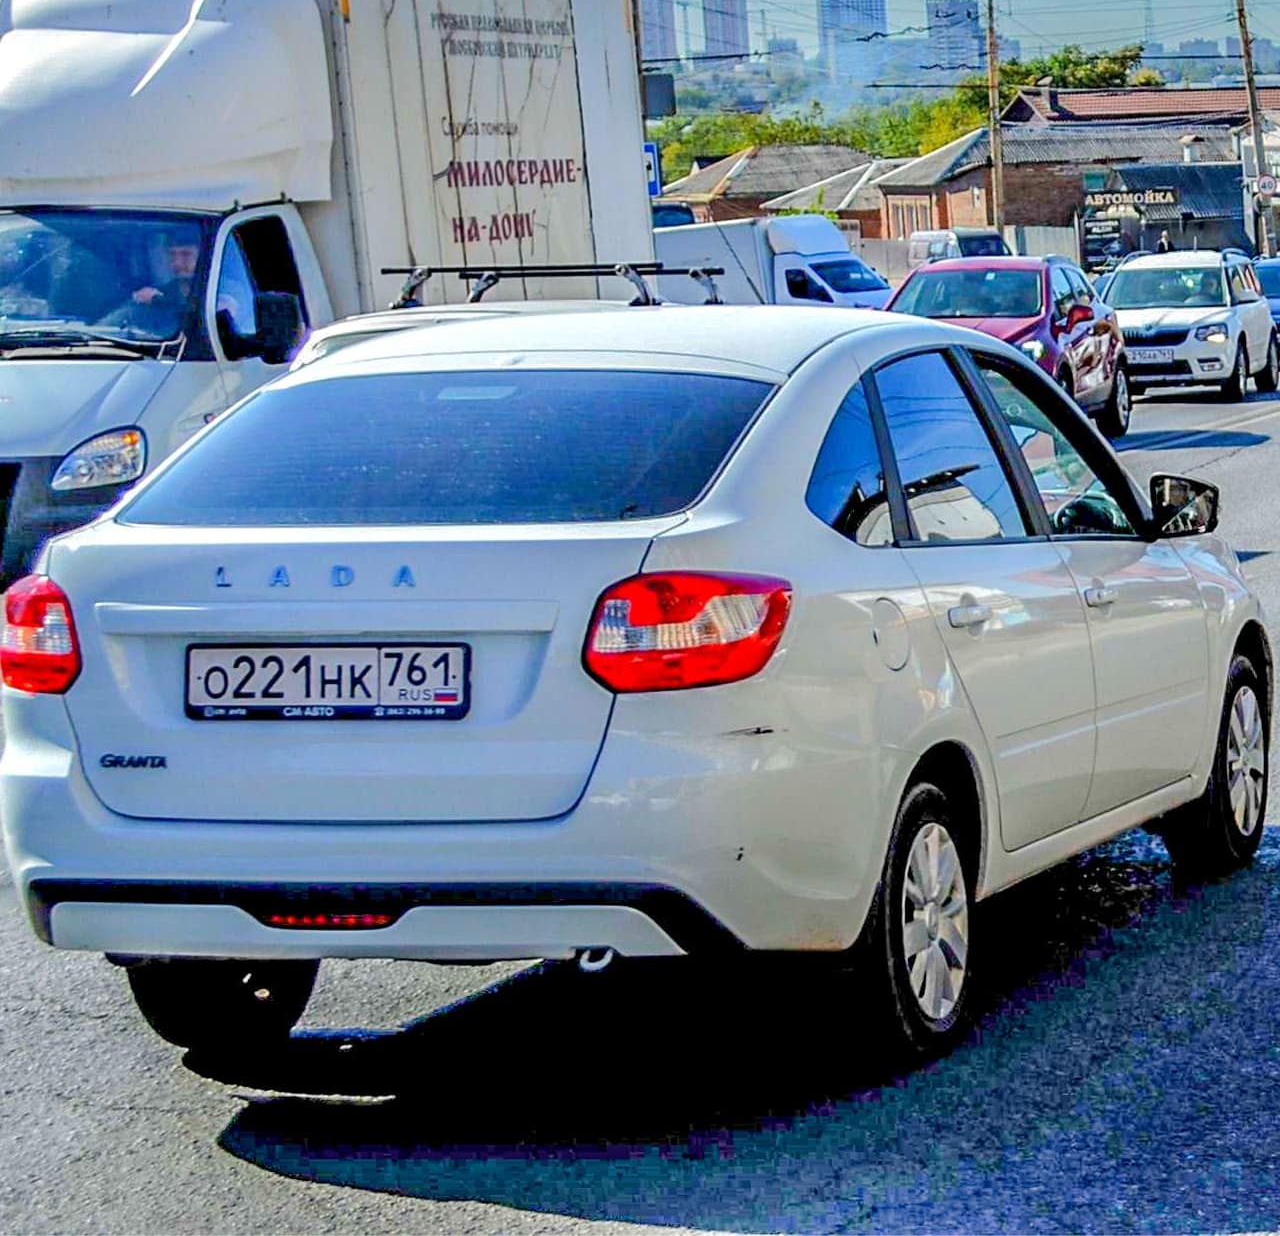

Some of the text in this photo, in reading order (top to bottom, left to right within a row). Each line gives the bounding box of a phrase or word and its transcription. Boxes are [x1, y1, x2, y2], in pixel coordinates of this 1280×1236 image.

[1260, 181, 1273, 189] 40
[1085, 190, 1174, 205] АВТОМОЙКА
[215, 565, 416, 587] LADA
[203, 652, 450, 699] О221НК 761
[398, 689, 432, 701] RUS
[100, 753, 168, 769] GRANTA
